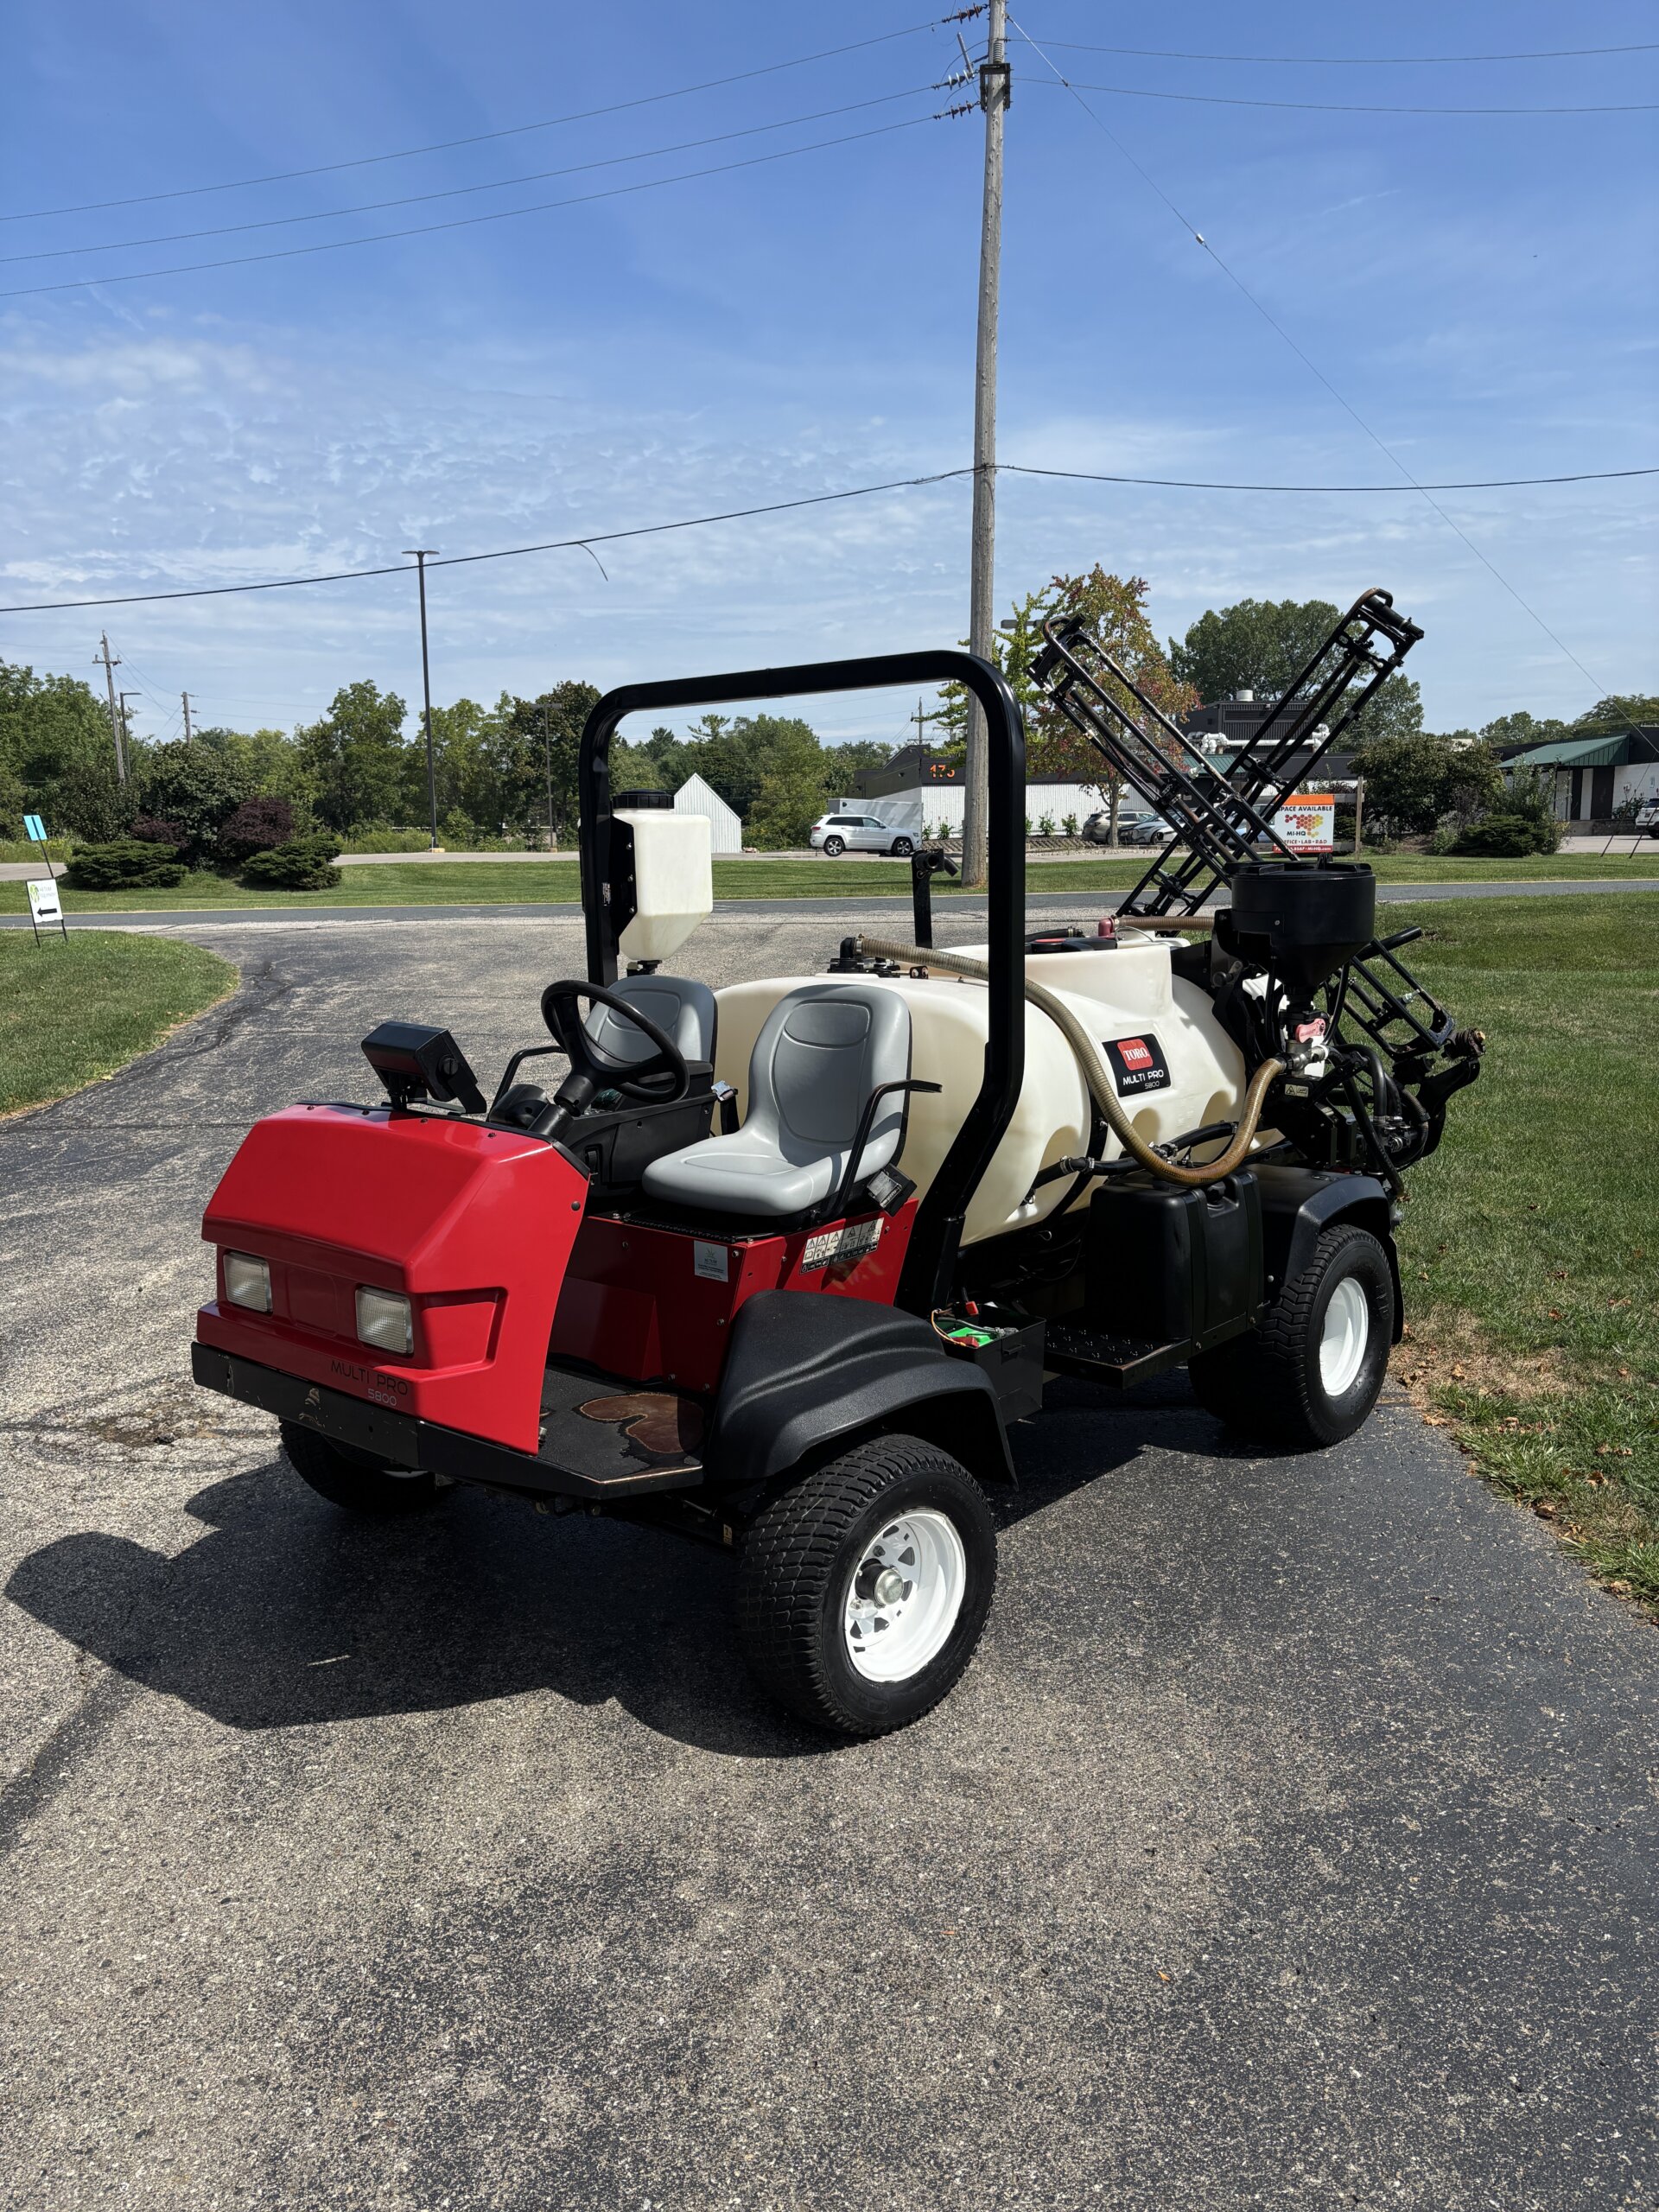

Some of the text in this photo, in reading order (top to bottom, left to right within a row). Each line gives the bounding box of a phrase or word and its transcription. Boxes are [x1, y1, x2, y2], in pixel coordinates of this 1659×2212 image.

[1123, 1046, 1147, 1061] TORO
[1123, 1070, 1164, 1085] MULTI PRO
[331, 1360, 408, 1395] MULTI PRO
[367, 1388, 397, 1406] 5800
